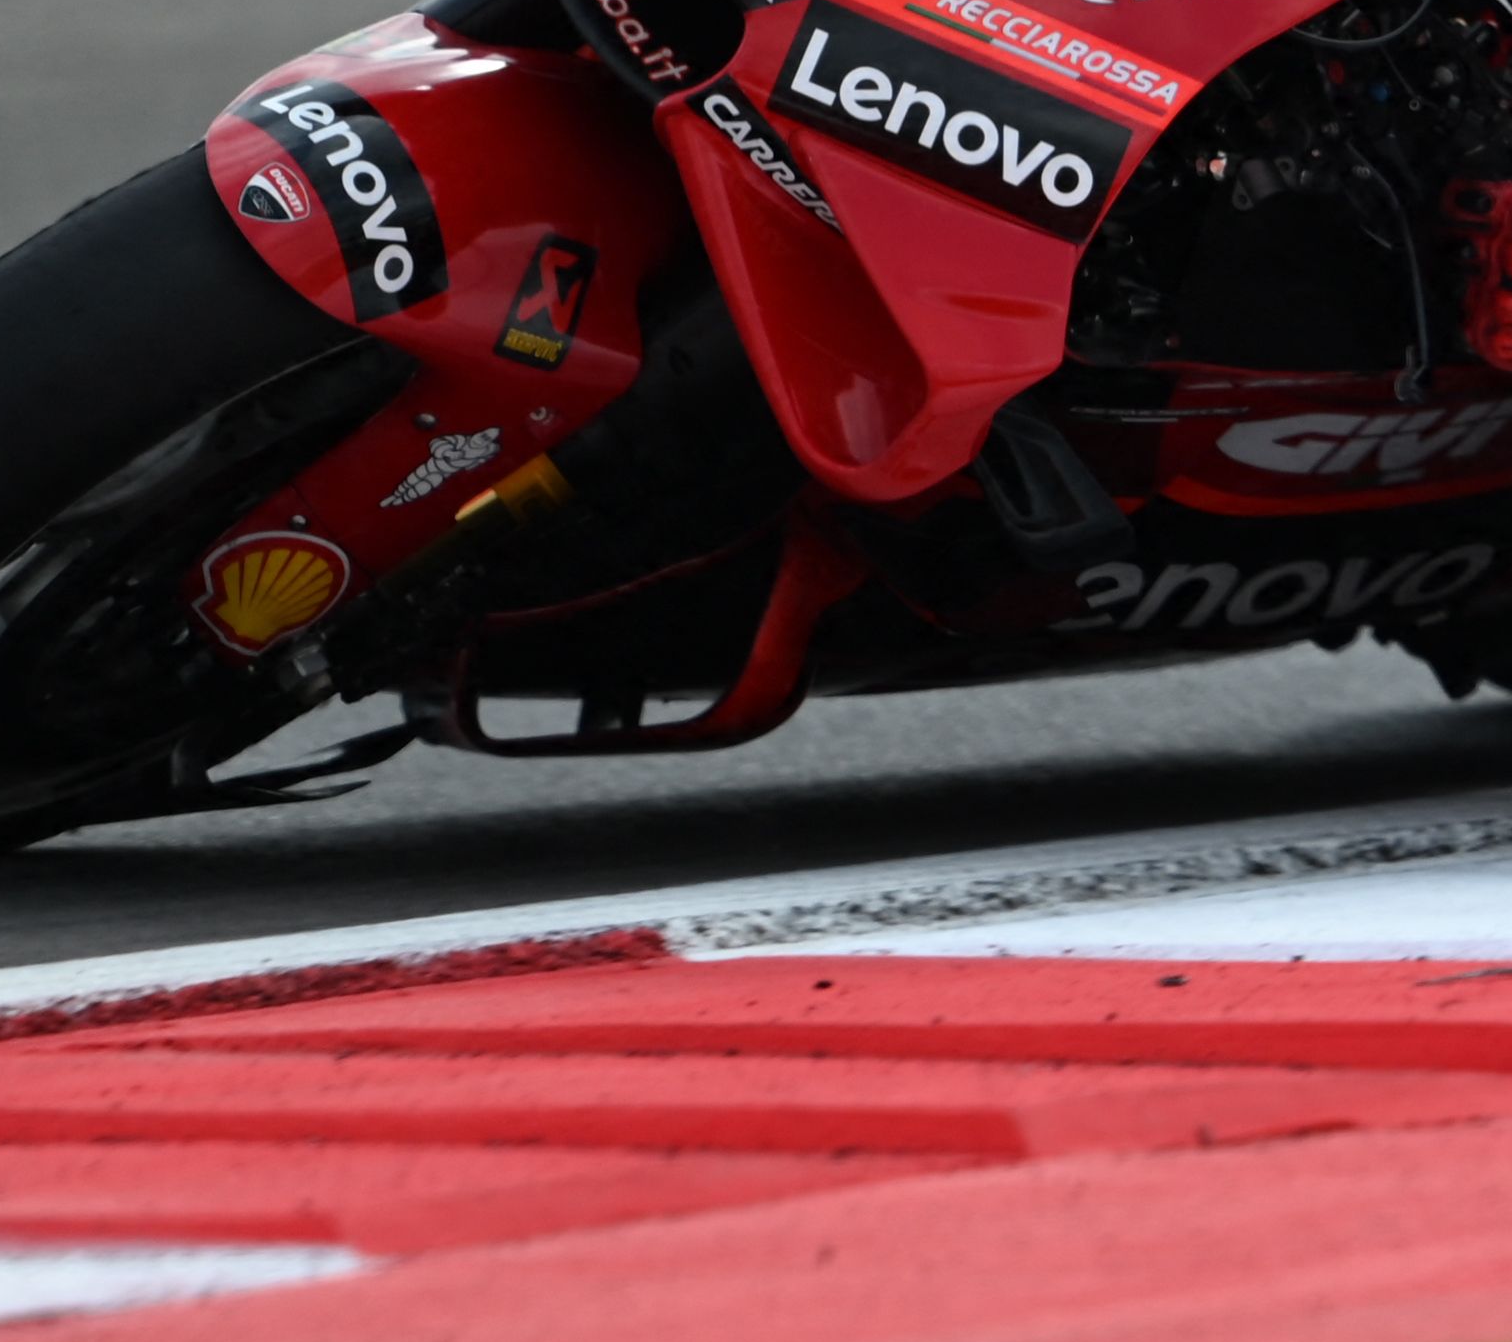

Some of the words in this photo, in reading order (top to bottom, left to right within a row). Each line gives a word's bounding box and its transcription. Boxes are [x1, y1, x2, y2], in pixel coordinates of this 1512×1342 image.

[260, 84, 414, 294] Lenovo
[269, 168, 305, 213] DUCATI
[790, 28, 1094, 208] Lenovo
